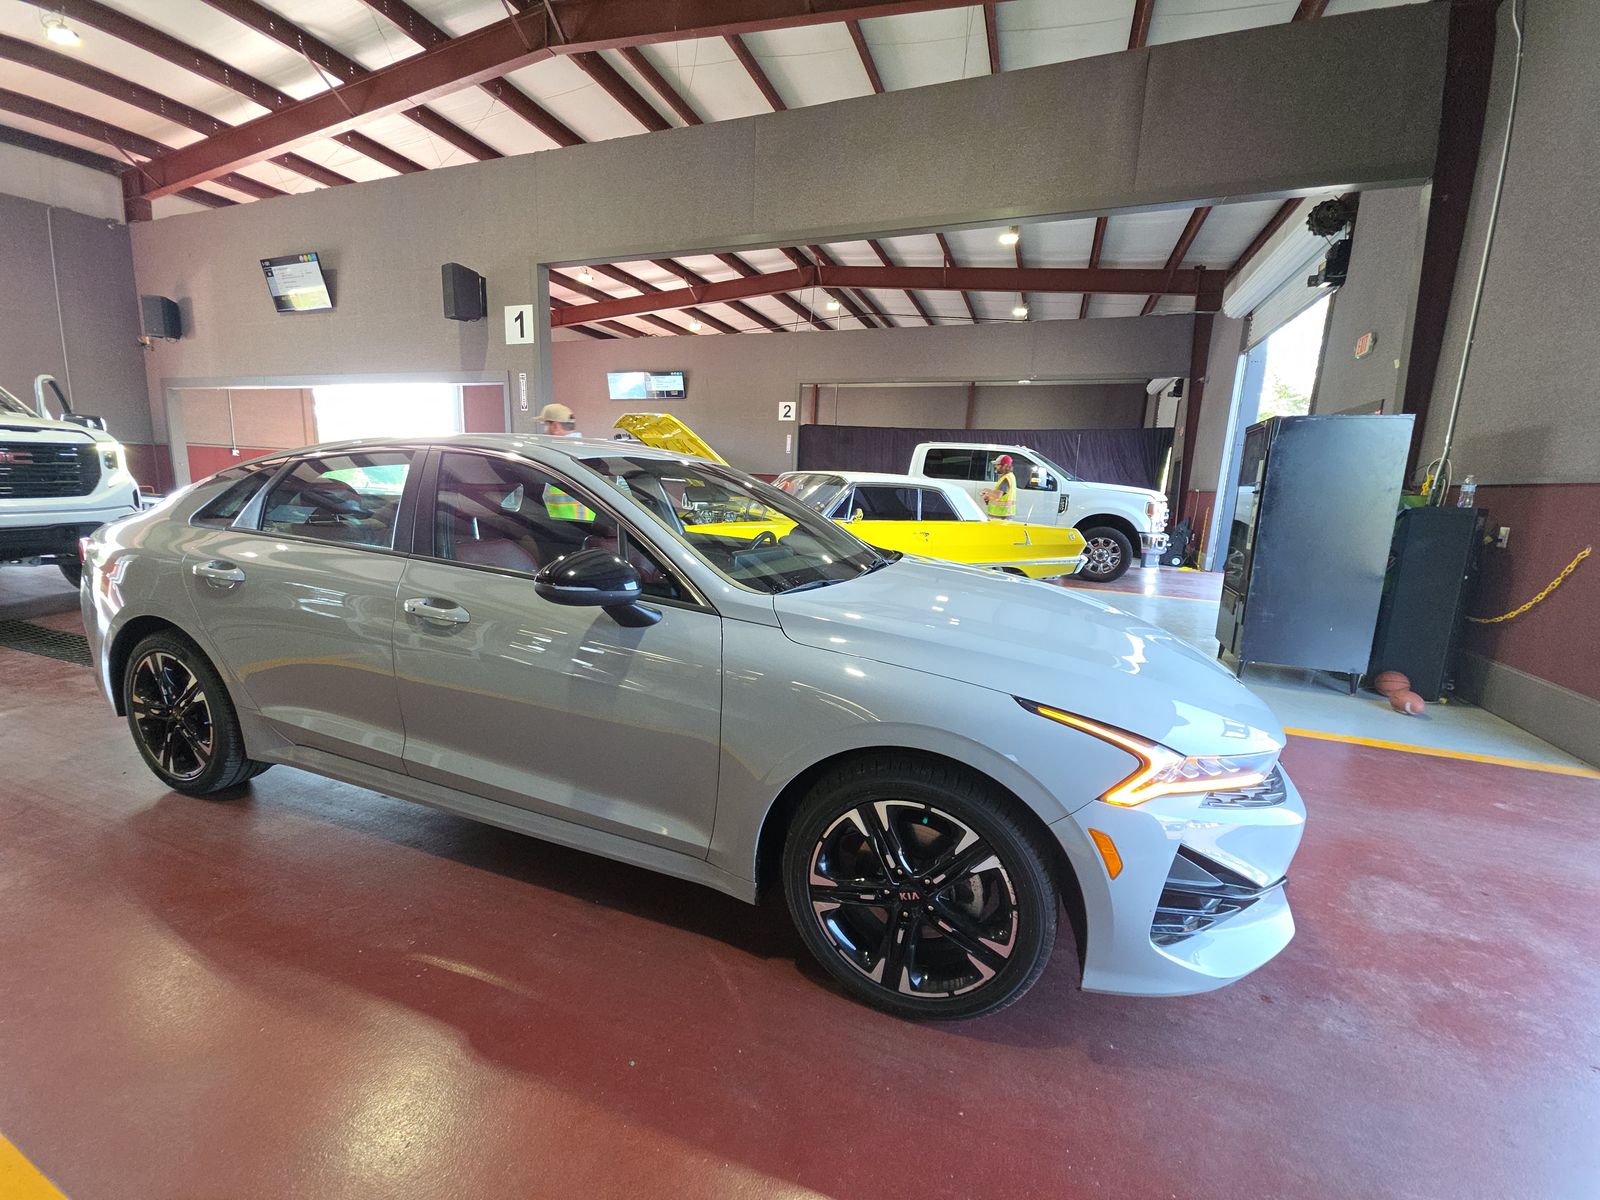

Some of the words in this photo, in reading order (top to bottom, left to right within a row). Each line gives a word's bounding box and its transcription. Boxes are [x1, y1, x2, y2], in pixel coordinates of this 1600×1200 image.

[514, 311, 525, 338] 1
[783, 404, 792, 418] 2
[899, 892, 920, 900] KIA
